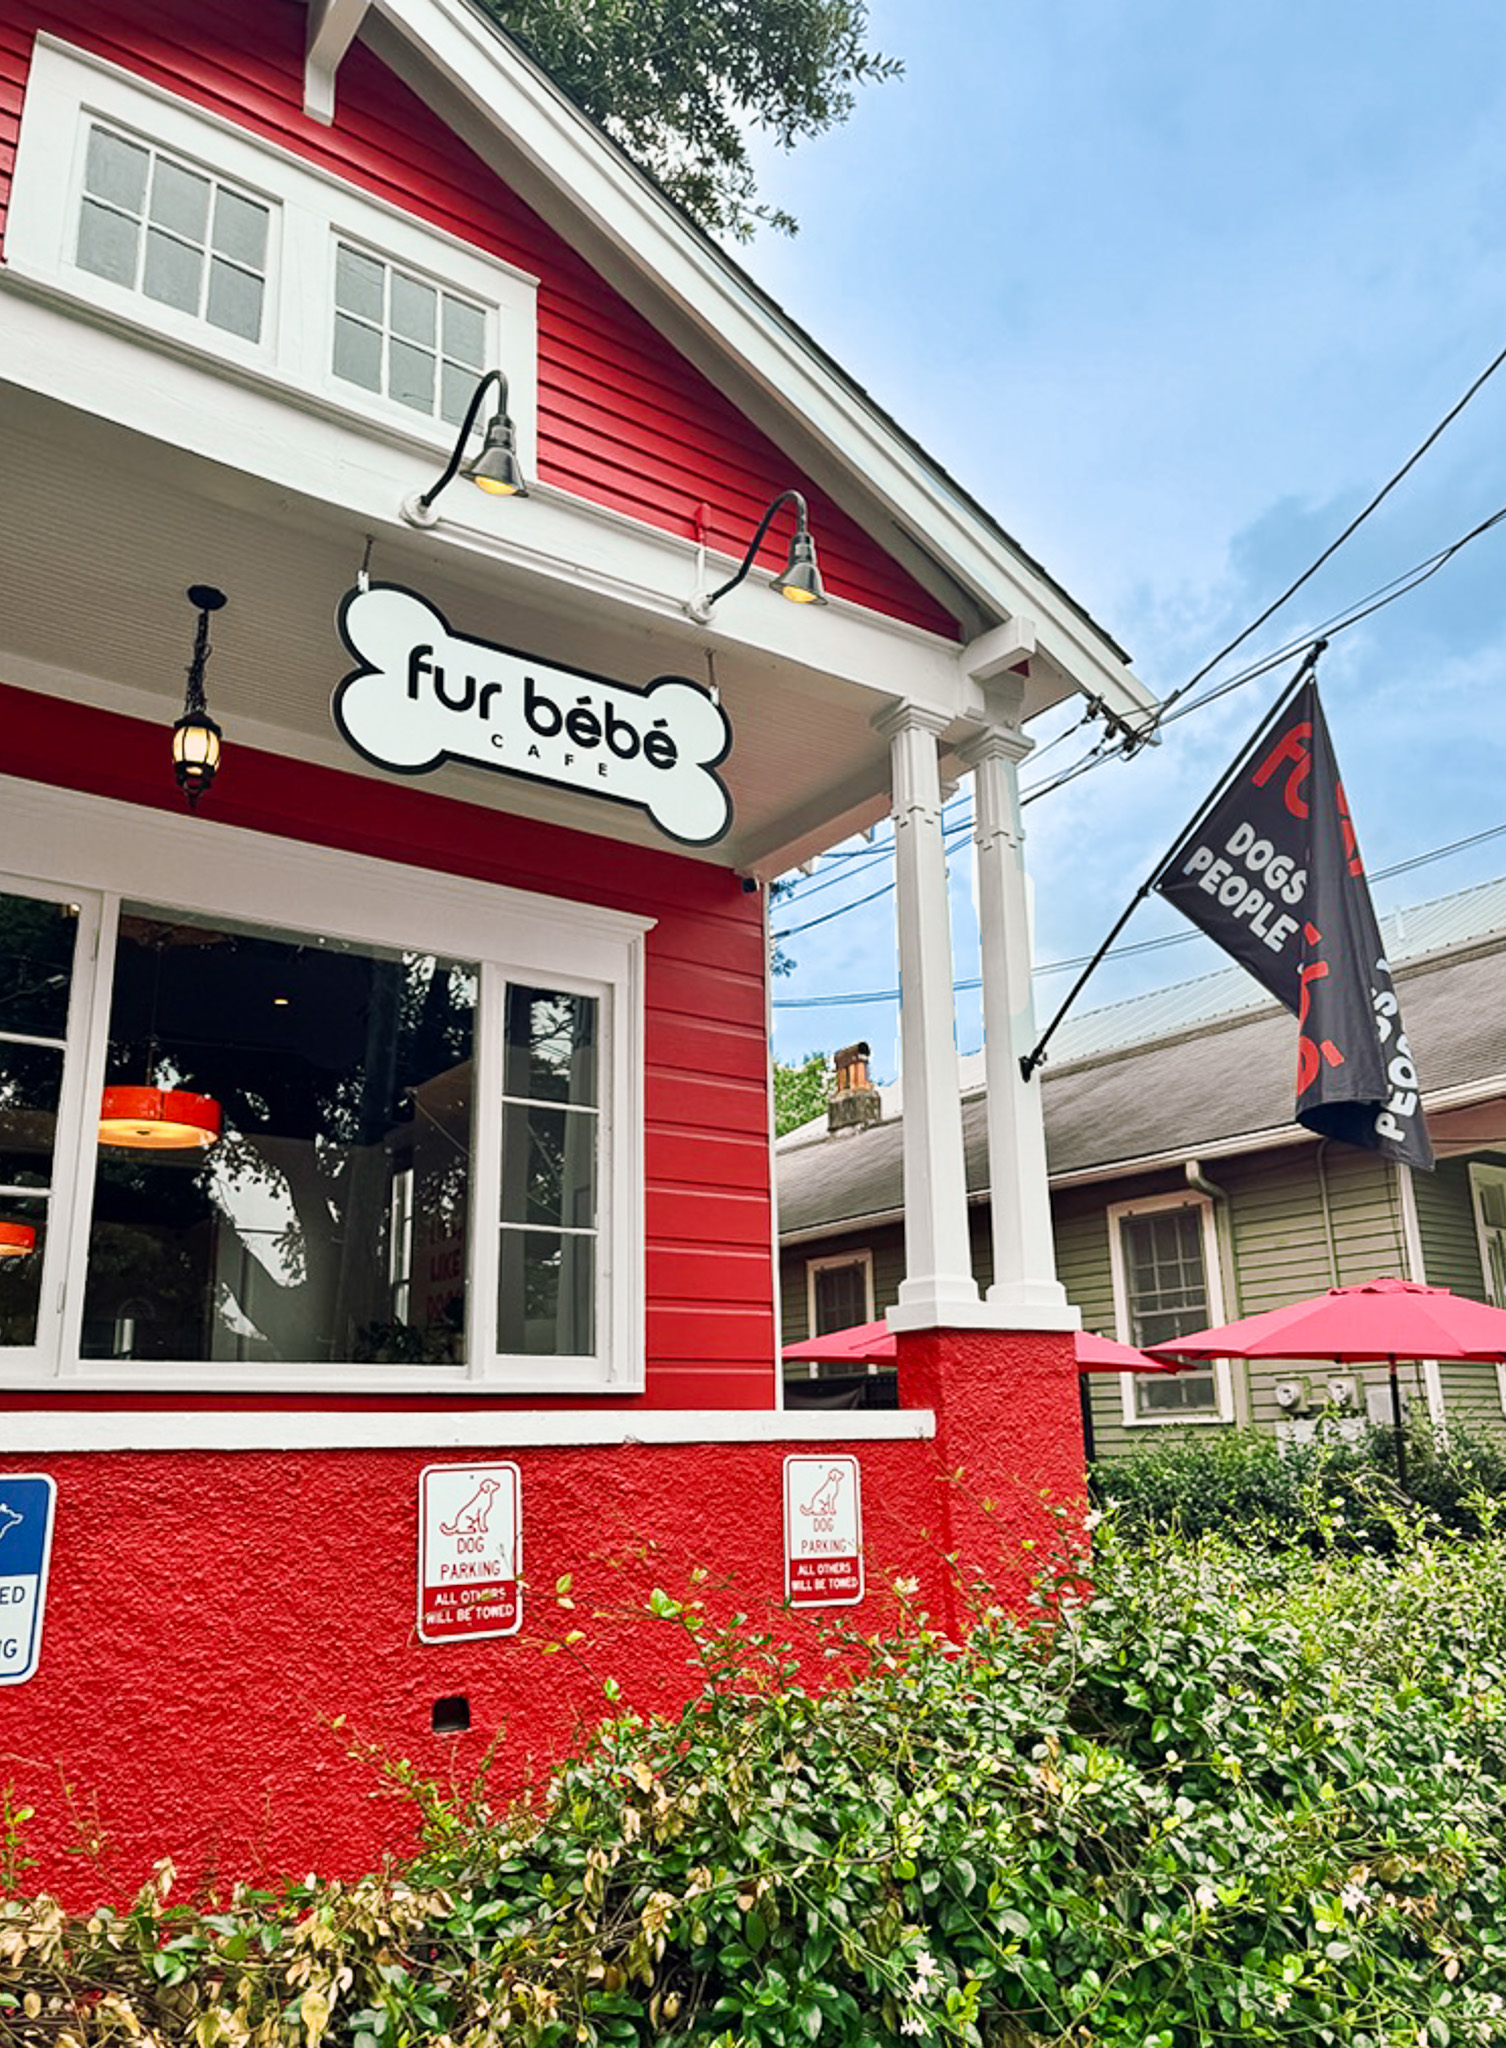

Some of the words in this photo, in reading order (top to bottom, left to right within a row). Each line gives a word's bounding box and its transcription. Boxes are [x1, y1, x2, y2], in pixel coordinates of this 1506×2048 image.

[407, 644, 502, 720] fur
[524, 676, 678, 770] bébé
[491, 733, 608, 777] CAFE
[1224, 822, 1308, 904] DOGS
[1182, 845, 1300, 953] PEOPLE
[813, 1517, 834, 1532] DOG
[456, 1535, 484, 1553] DOG
[801, 1538, 846, 1554] PARKING
[440, 1558, 500, 1580] PARKING
[797, 1564, 815, 1576] ALL
[817, 1562, 852, 1575] OTHERS
[791, 1580, 812, 1592] WILL
[814, 1578, 827, 1590] BE
[828, 1576, 859, 1590] TOWED
[435, 1592, 458, 1606] ALL
[426, 1609, 453, 1625] WILL
[457, 1608, 472, 1622] BE
[476, 1602, 514, 1619] TOWED
